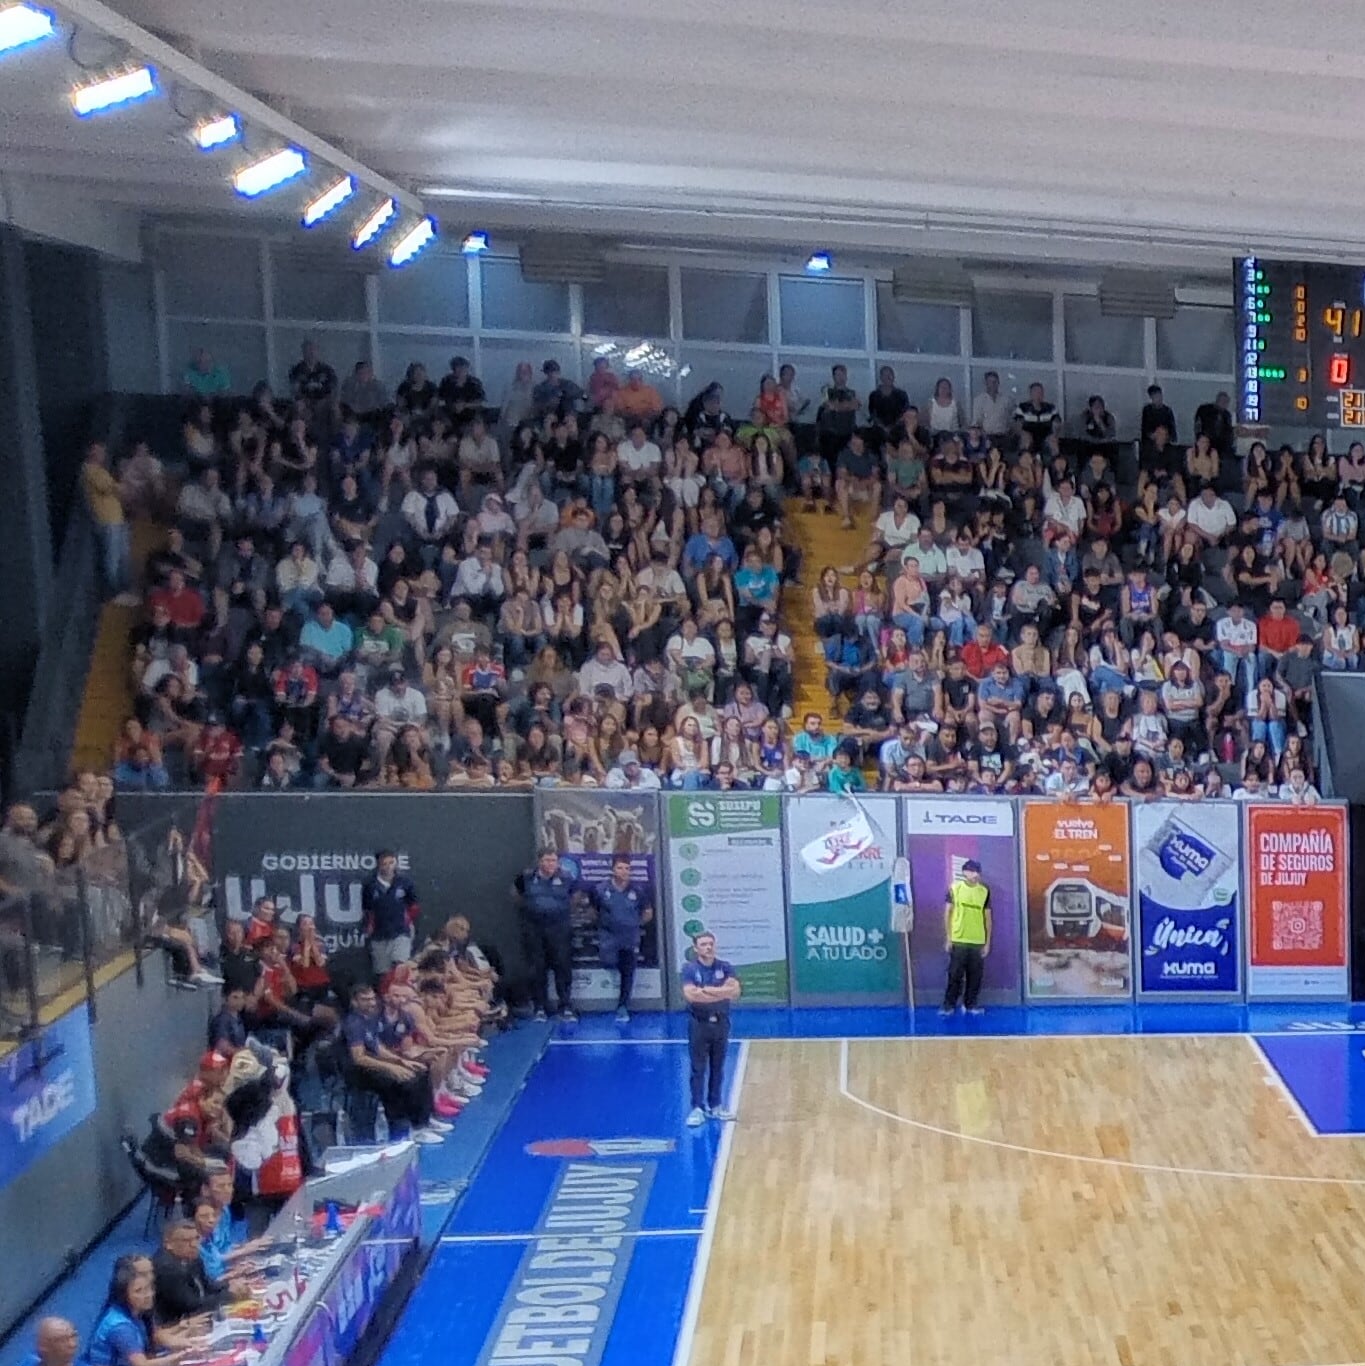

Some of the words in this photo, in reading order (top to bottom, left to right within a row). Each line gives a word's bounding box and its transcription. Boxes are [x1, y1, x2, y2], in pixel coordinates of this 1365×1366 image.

[1325, 308, 1360, 337] 41
[1331, 359, 1347, 383] 0
[1344, 393, 1361, 406] 21
[1345, 411, 1362, 424] 21
[935, 813, 998, 825] TADE
[1054, 828, 1067, 840] EL
[1068, 828, 1098, 840] TREN
[1260, 828, 1333, 854] COMPAÑÍA
[262, 855, 377, 870] GOBIERNO
[1260, 854, 1277, 871] DE
[1279, 854, 1334, 871] SEGUROS
[1260, 872, 1275, 886] DE
[1276, 872, 1308, 887] JUJUY
[805, 925, 866, 946] SALUD
[807, 947, 821, 960] A
[823, 947, 840, 960] TU
[843, 947, 888, 960] LADO
[544, 1164, 644, 1233] JUJUY
[529, 1234, 623, 1269] DE
